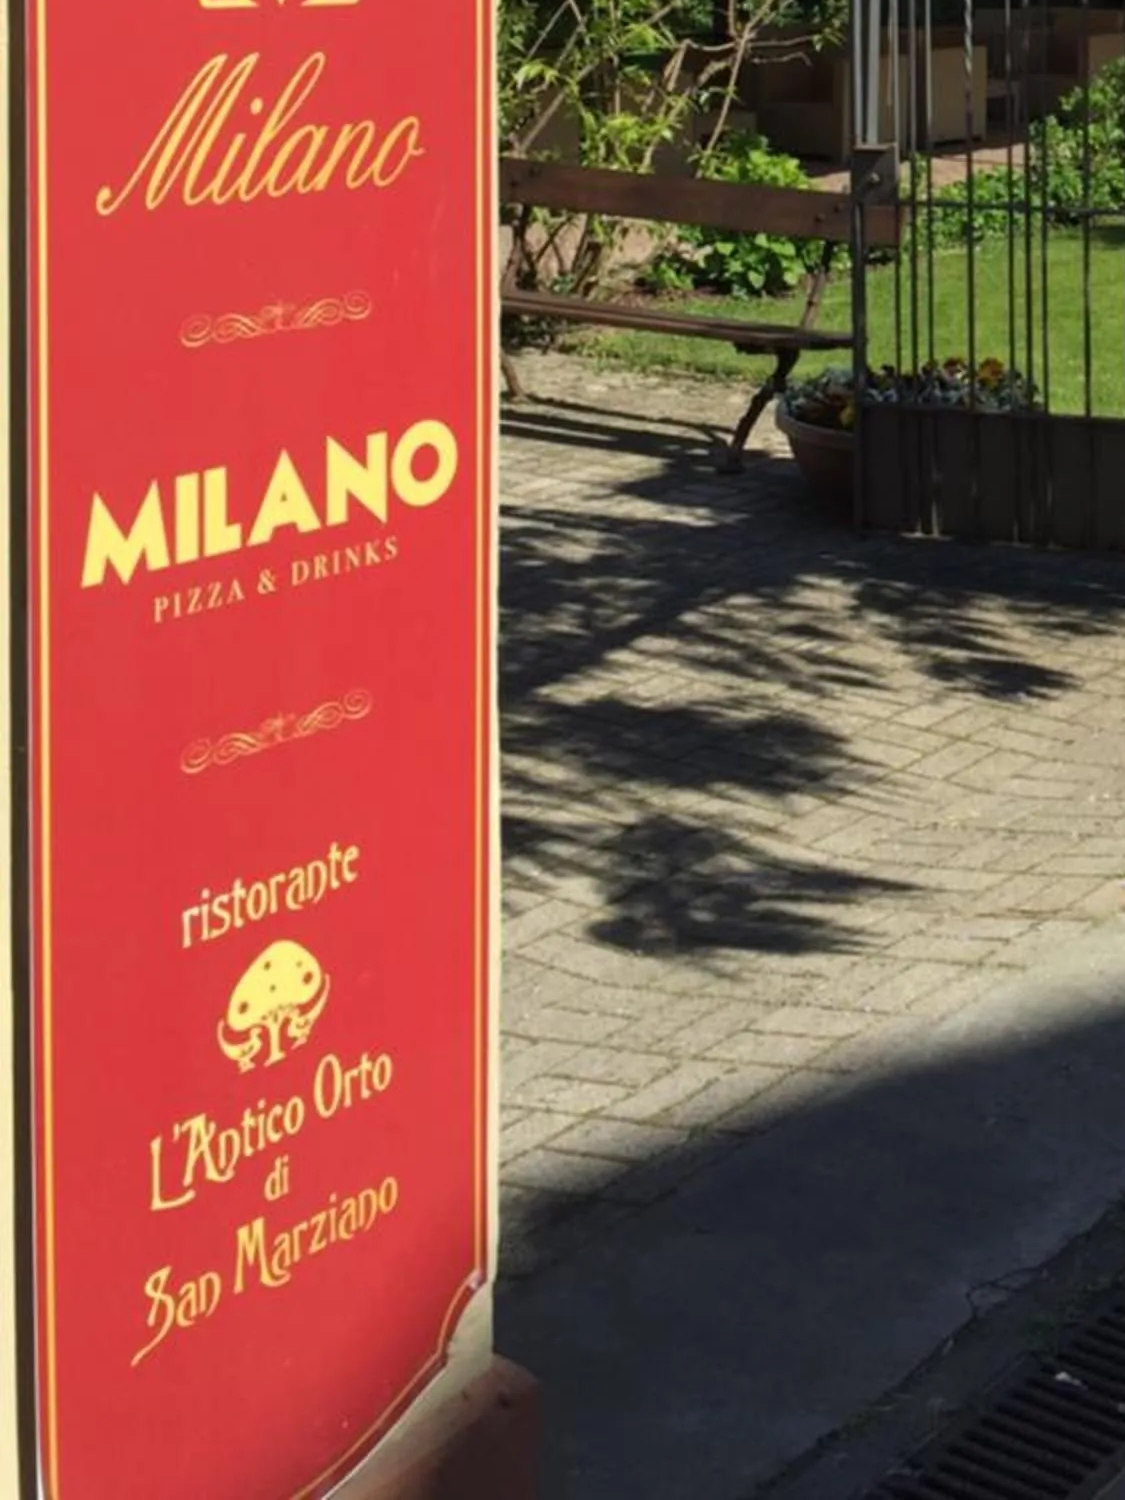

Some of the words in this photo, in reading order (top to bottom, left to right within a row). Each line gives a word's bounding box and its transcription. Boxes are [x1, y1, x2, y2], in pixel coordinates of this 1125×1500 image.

[95, 51, 426, 216] Milano
[80, 418, 459, 590] MILANO
[153, 580, 246, 624] PIZZA
[257, 569, 276, 596] &
[290, 536, 400, 587] DRINKS
[181, 842, 361, 949] ristorante
[149, 1096, 305, 1212] L'Antico
[313, 1053, 393, 1120] Orto
[264, 1155, 289, 1201] di
[130, 1266, 221, 1367] San
[233, 1176, 400, 1294] Marziano
